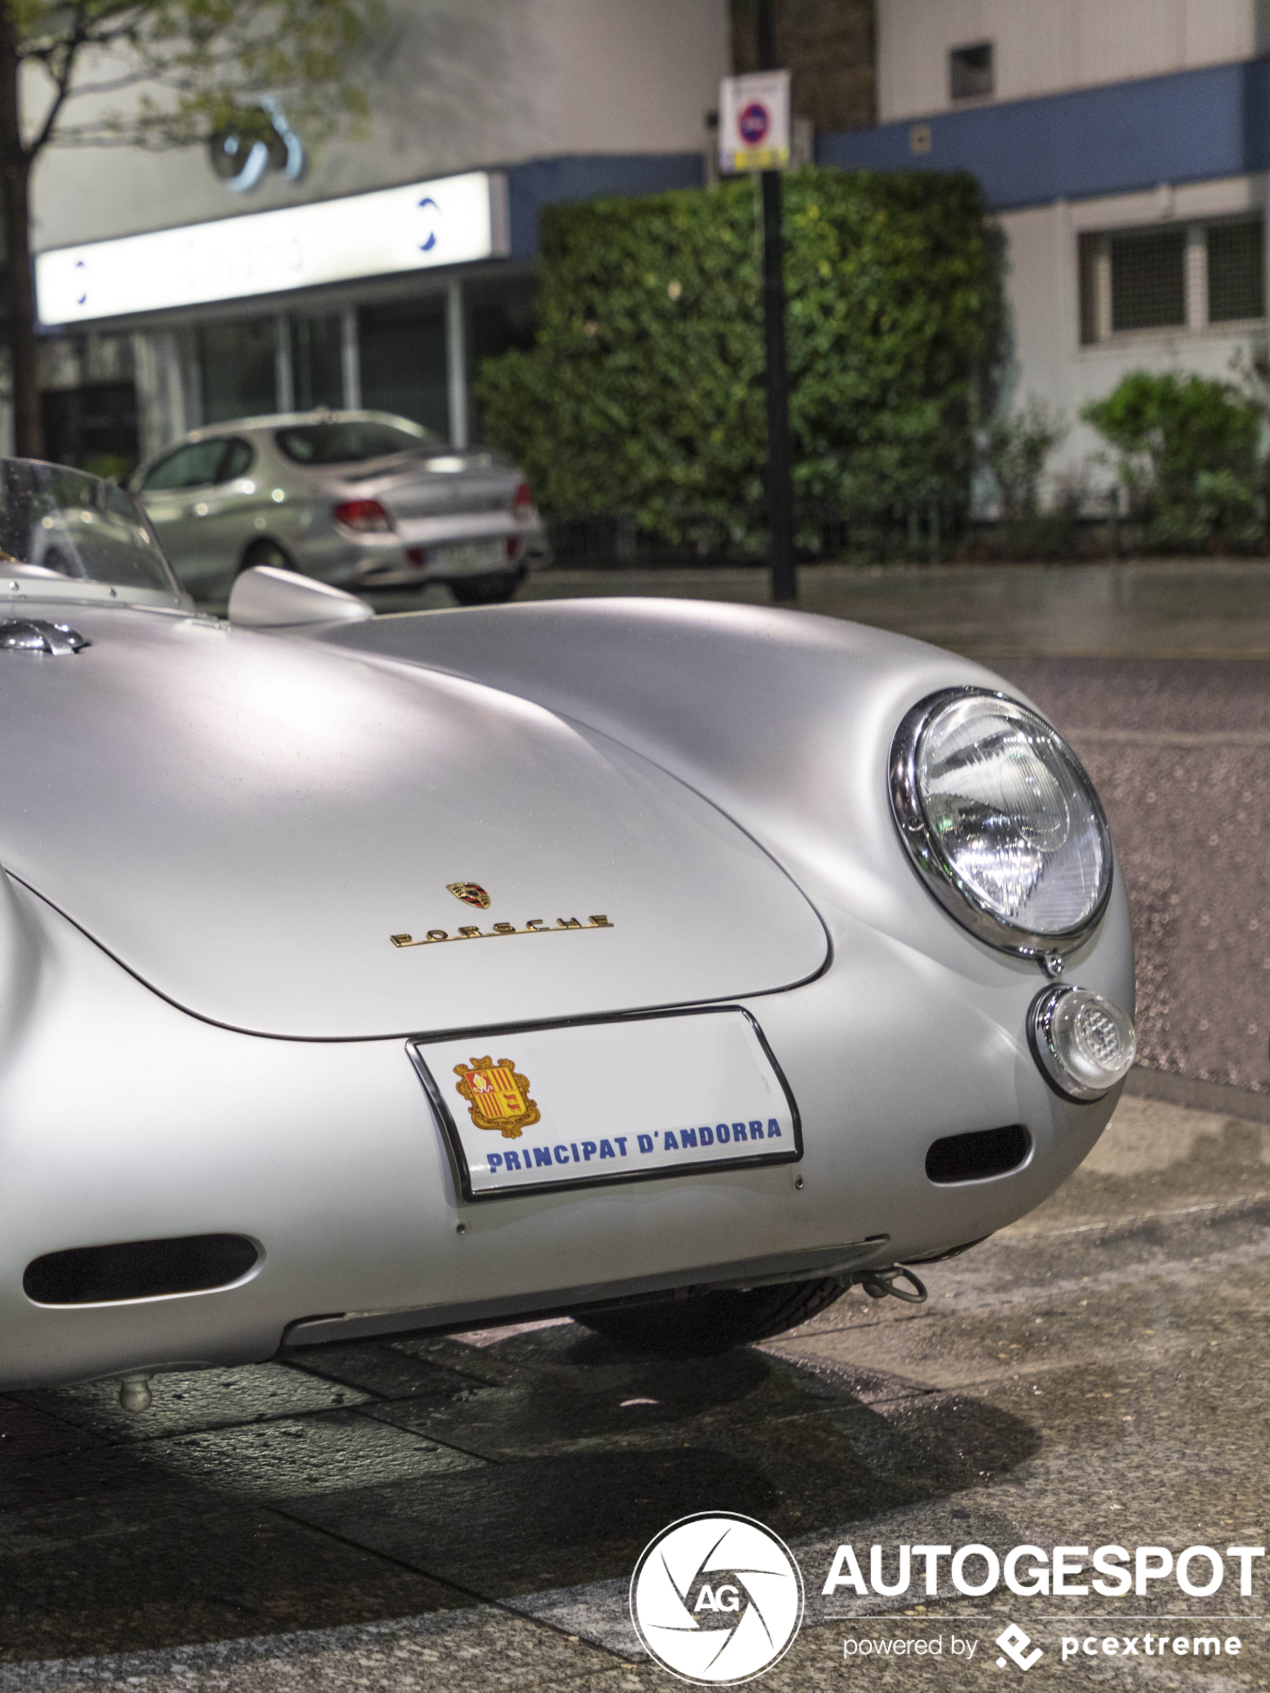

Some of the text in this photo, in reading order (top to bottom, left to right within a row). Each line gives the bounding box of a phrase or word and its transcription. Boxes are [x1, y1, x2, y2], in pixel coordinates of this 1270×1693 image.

[390, 914, 614, 947] PORSCHE
[486, 1118, 782, 1173] PRINCIPAT D'ANDORRA
